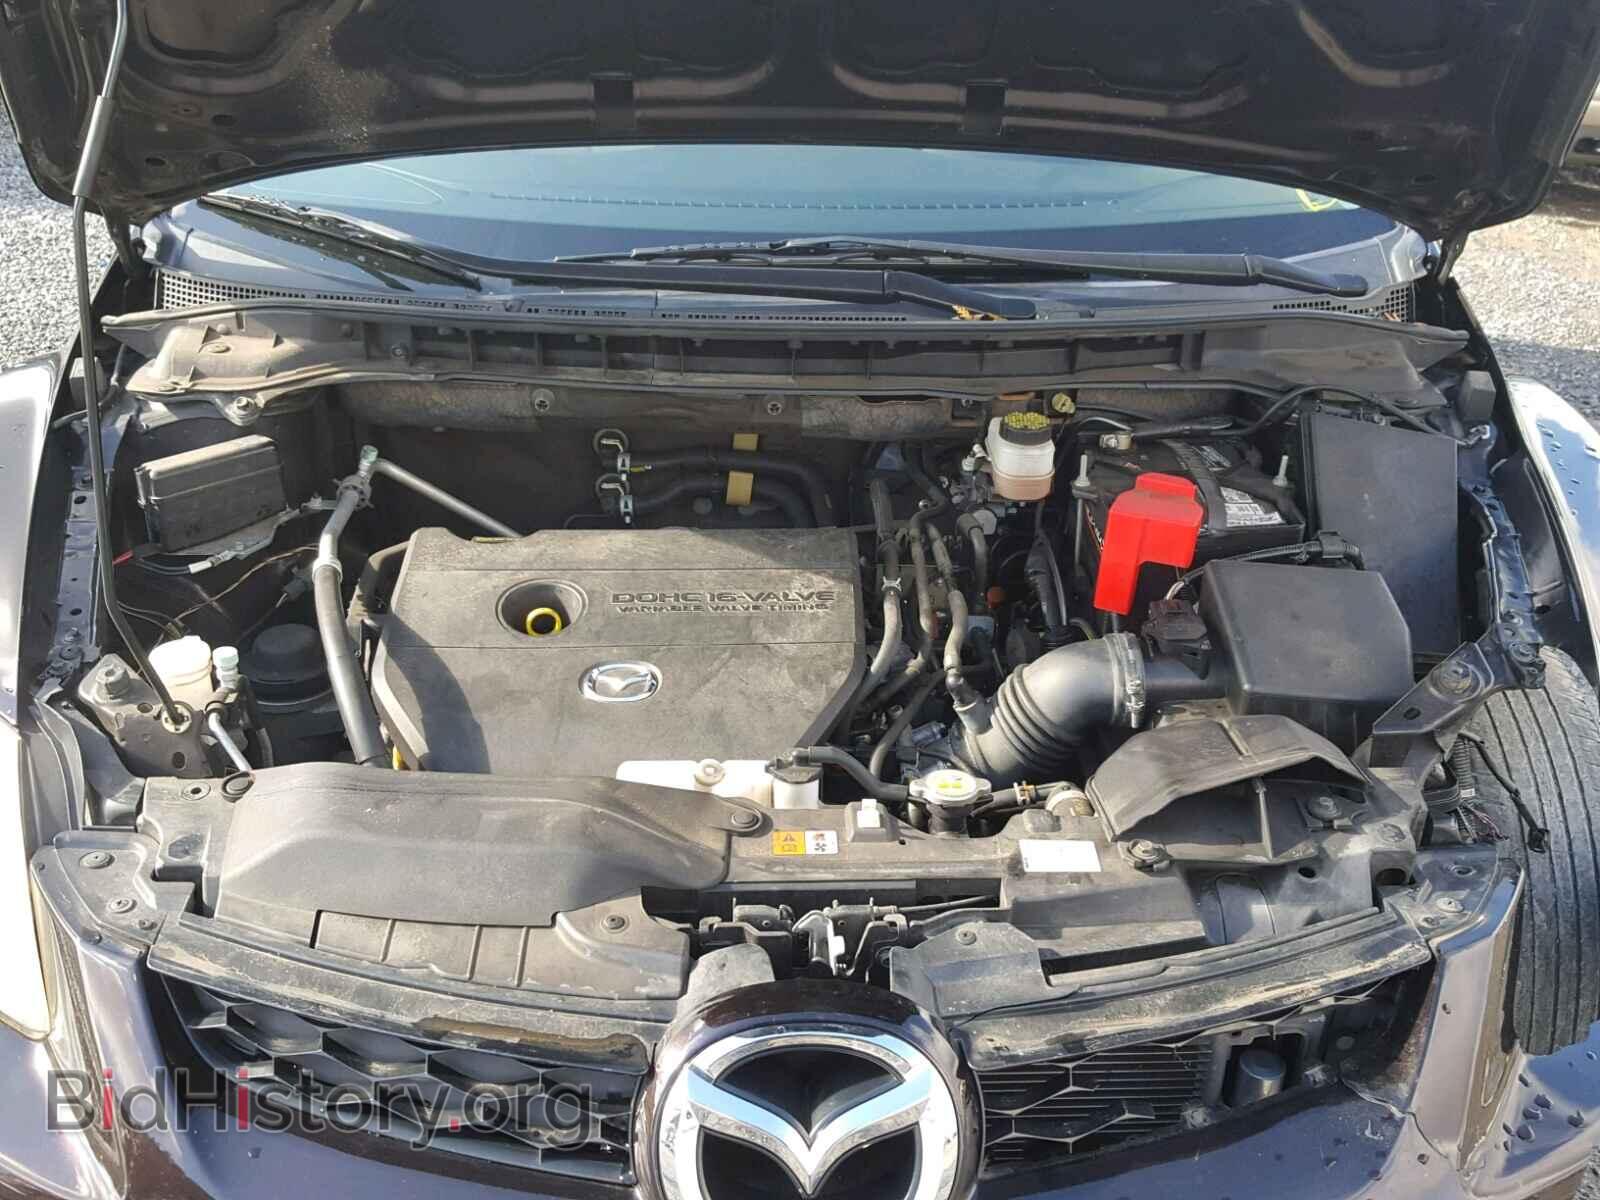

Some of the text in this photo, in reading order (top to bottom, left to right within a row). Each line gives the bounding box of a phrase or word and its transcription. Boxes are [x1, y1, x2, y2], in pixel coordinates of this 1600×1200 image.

[612, 591, 834, 604] DOHC 16-VALVE
[708, 604, 762, 613] VALVE
[767, 603, 831, 612] TIMING
